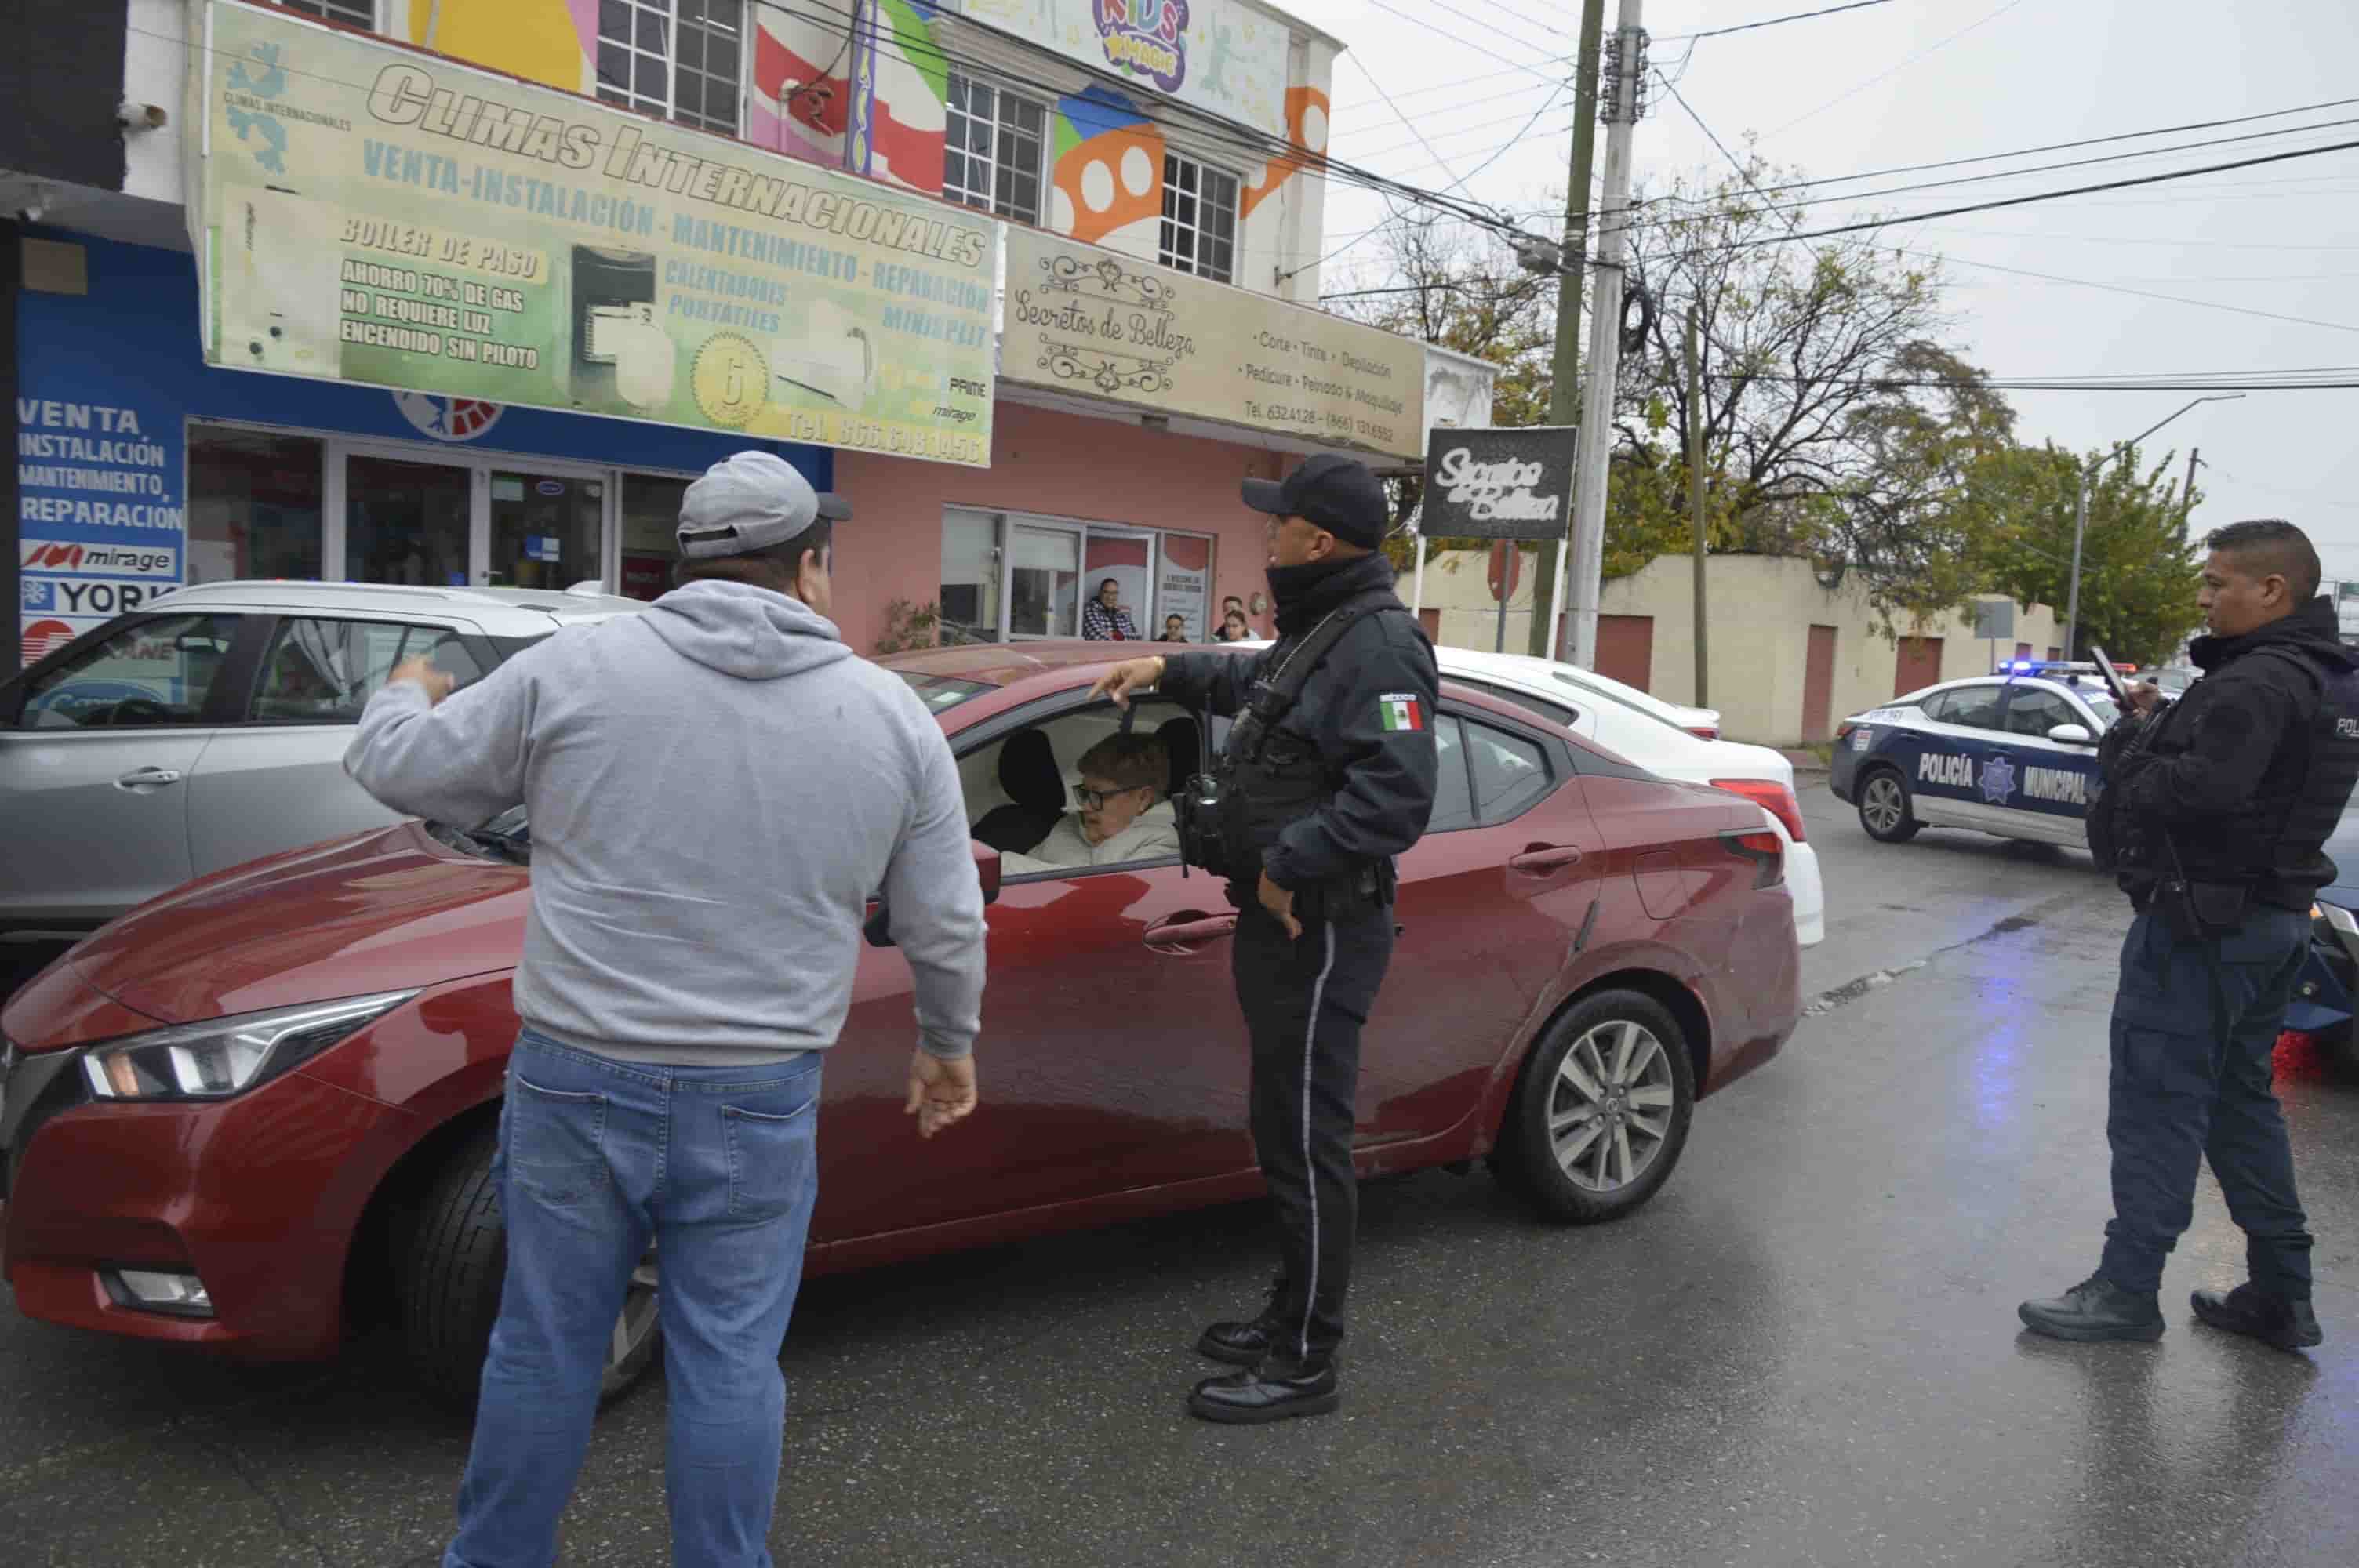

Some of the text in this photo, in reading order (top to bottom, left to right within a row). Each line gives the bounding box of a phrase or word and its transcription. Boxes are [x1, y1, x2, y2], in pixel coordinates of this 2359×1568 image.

[340, 218, 539, 279] BOILER DE PASO
[673, 212, 858, 283] MANTENIMIENTO
[340, 258, 525, 314] AHORRO 70% DE GAS
[340, 288, 493, 337] NO REQUIERE LUZ
[1014, 289, 1196, 360] Secretos de Belleza
[340, 318, 540, 371] ENCENDIDO SIN PILOTO
[1259, 330, 1292, 352] Corte
[1300, 340, 1328, 362] Tinte
[1302, 375, 1343, 399] Peinado
[17, 397, 140, 435] VENTA
[932, 404, 977, 425] mirage
[85, 547, 171, 572] mirage
[1917, 751, 2088, 805] POLICÍA MUNICIPAL
